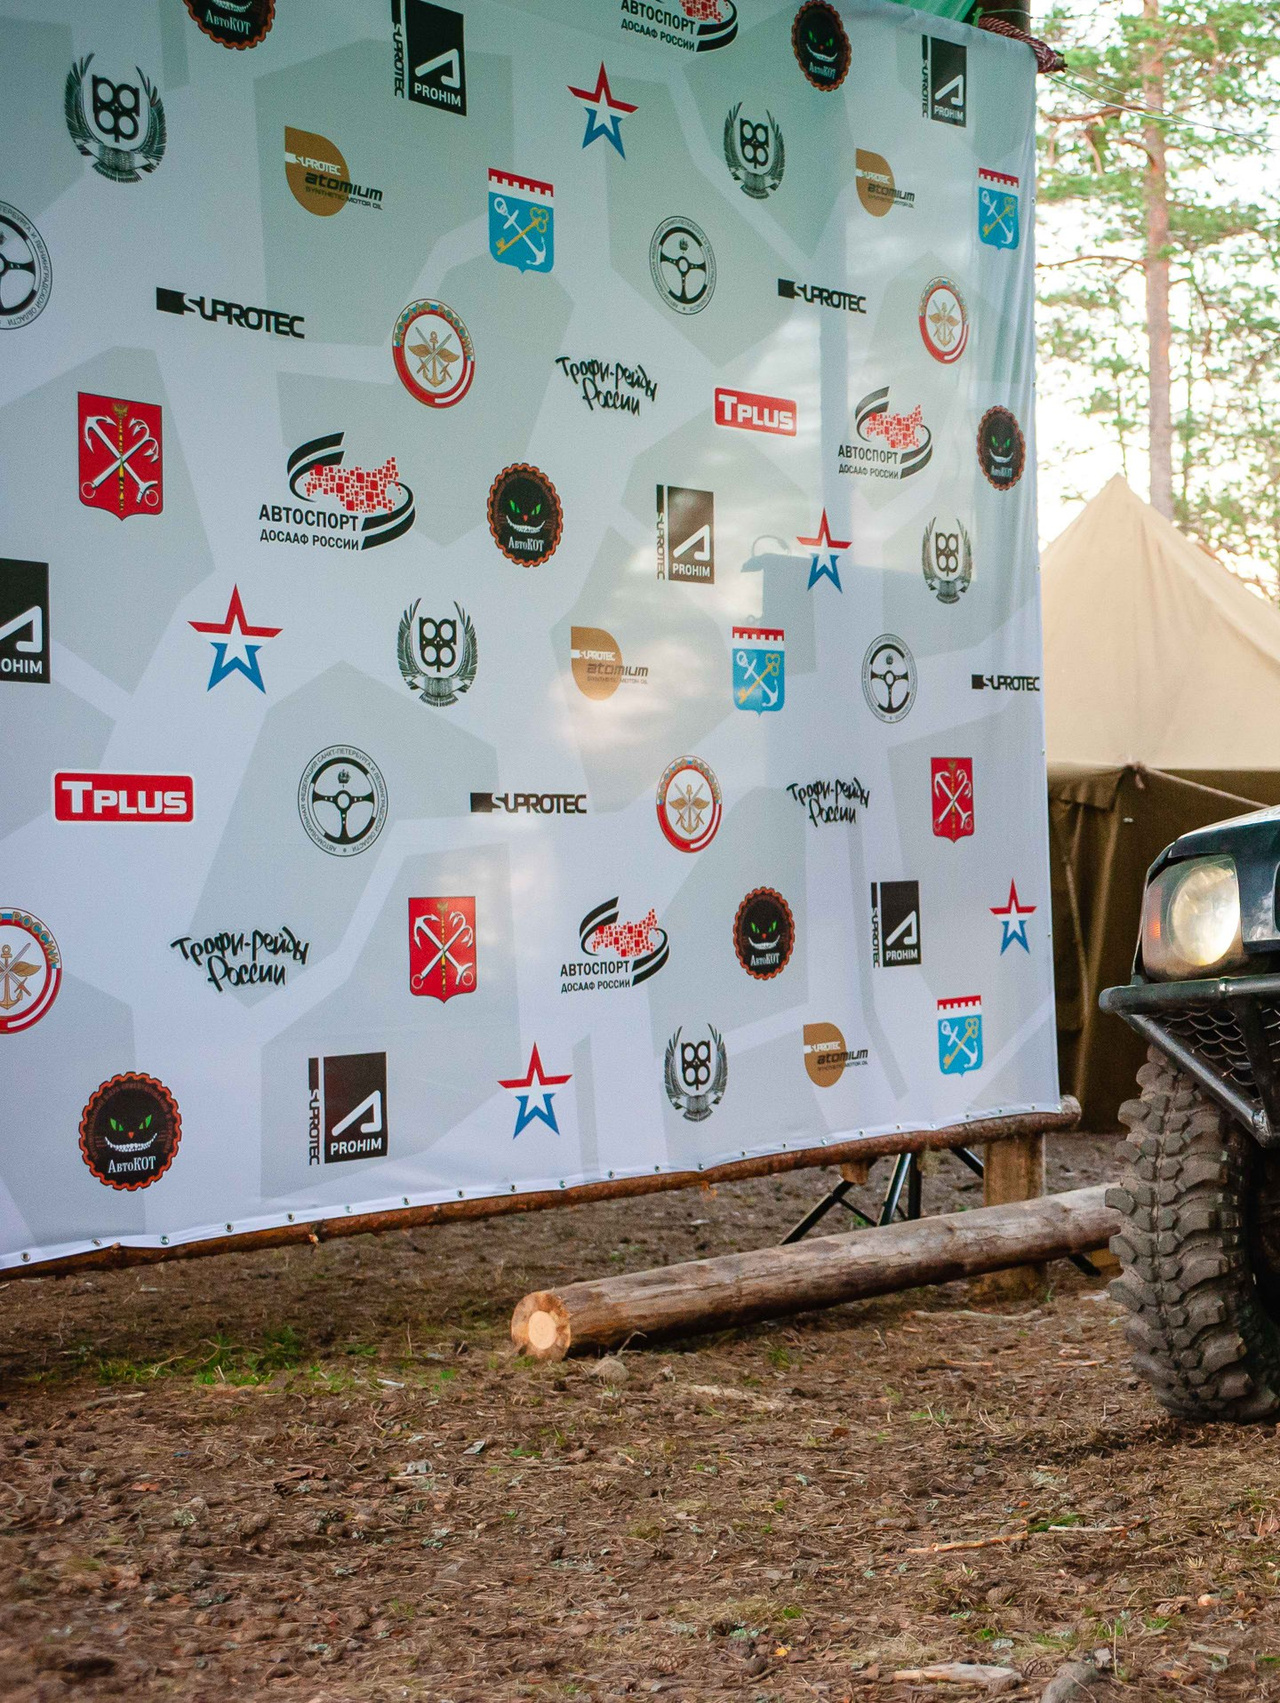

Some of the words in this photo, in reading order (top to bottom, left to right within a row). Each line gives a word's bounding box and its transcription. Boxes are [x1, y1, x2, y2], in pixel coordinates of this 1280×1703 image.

[620, 0, 696, 35] АВТОСПОРТ
[620, 18, 658, 39] ДОСААФ
[659, 31, 695, 51] РОССИИ
[414, 82, 461, 107] PROHIM
[933, 105, 964, 121] PROHIM
[305, 172, 383, 202] atomium
[793, 282, 867, 314] SUPROTEC
[182, 292, 305, 339] SUPROTEC
[582, 377, 640, 416] России
[838, 444, 899, 465] АВТОСПОРТ
[838, 462, 870, 477] ДОСААФ
[870, 466, 899, 480] РОССИИ
[259, 504, 358, 532] АВТОСПОРТ
[260, 529, 309, 545] ДОСААФ
[312, 535, 359, 551] РОССИИ
[672, 562, 711, 578] PROHIM
[1, 658, 43, 675] OHIM
[587, 663, 649, 677] atomium
[984, 675, 1040, 691] SUPROTEC
[491, 792, 587, 815] SUPROTEC
[809, 798, 856, 828] России
[886, 948, 918, 961] PROHIM
[207, 955, 286, 992] России
[560, 960, 630, 977] АВТОСПОРТ
[560, 981, 596, 994] ДОСААФ
[597, 979, 631, 991] РОССИИ
[817, 1049, 869, 1065] atomium
[309, 1089, 320, 1166] SUPROTEC
[330, 1137, 382, 1156] PROHIM
